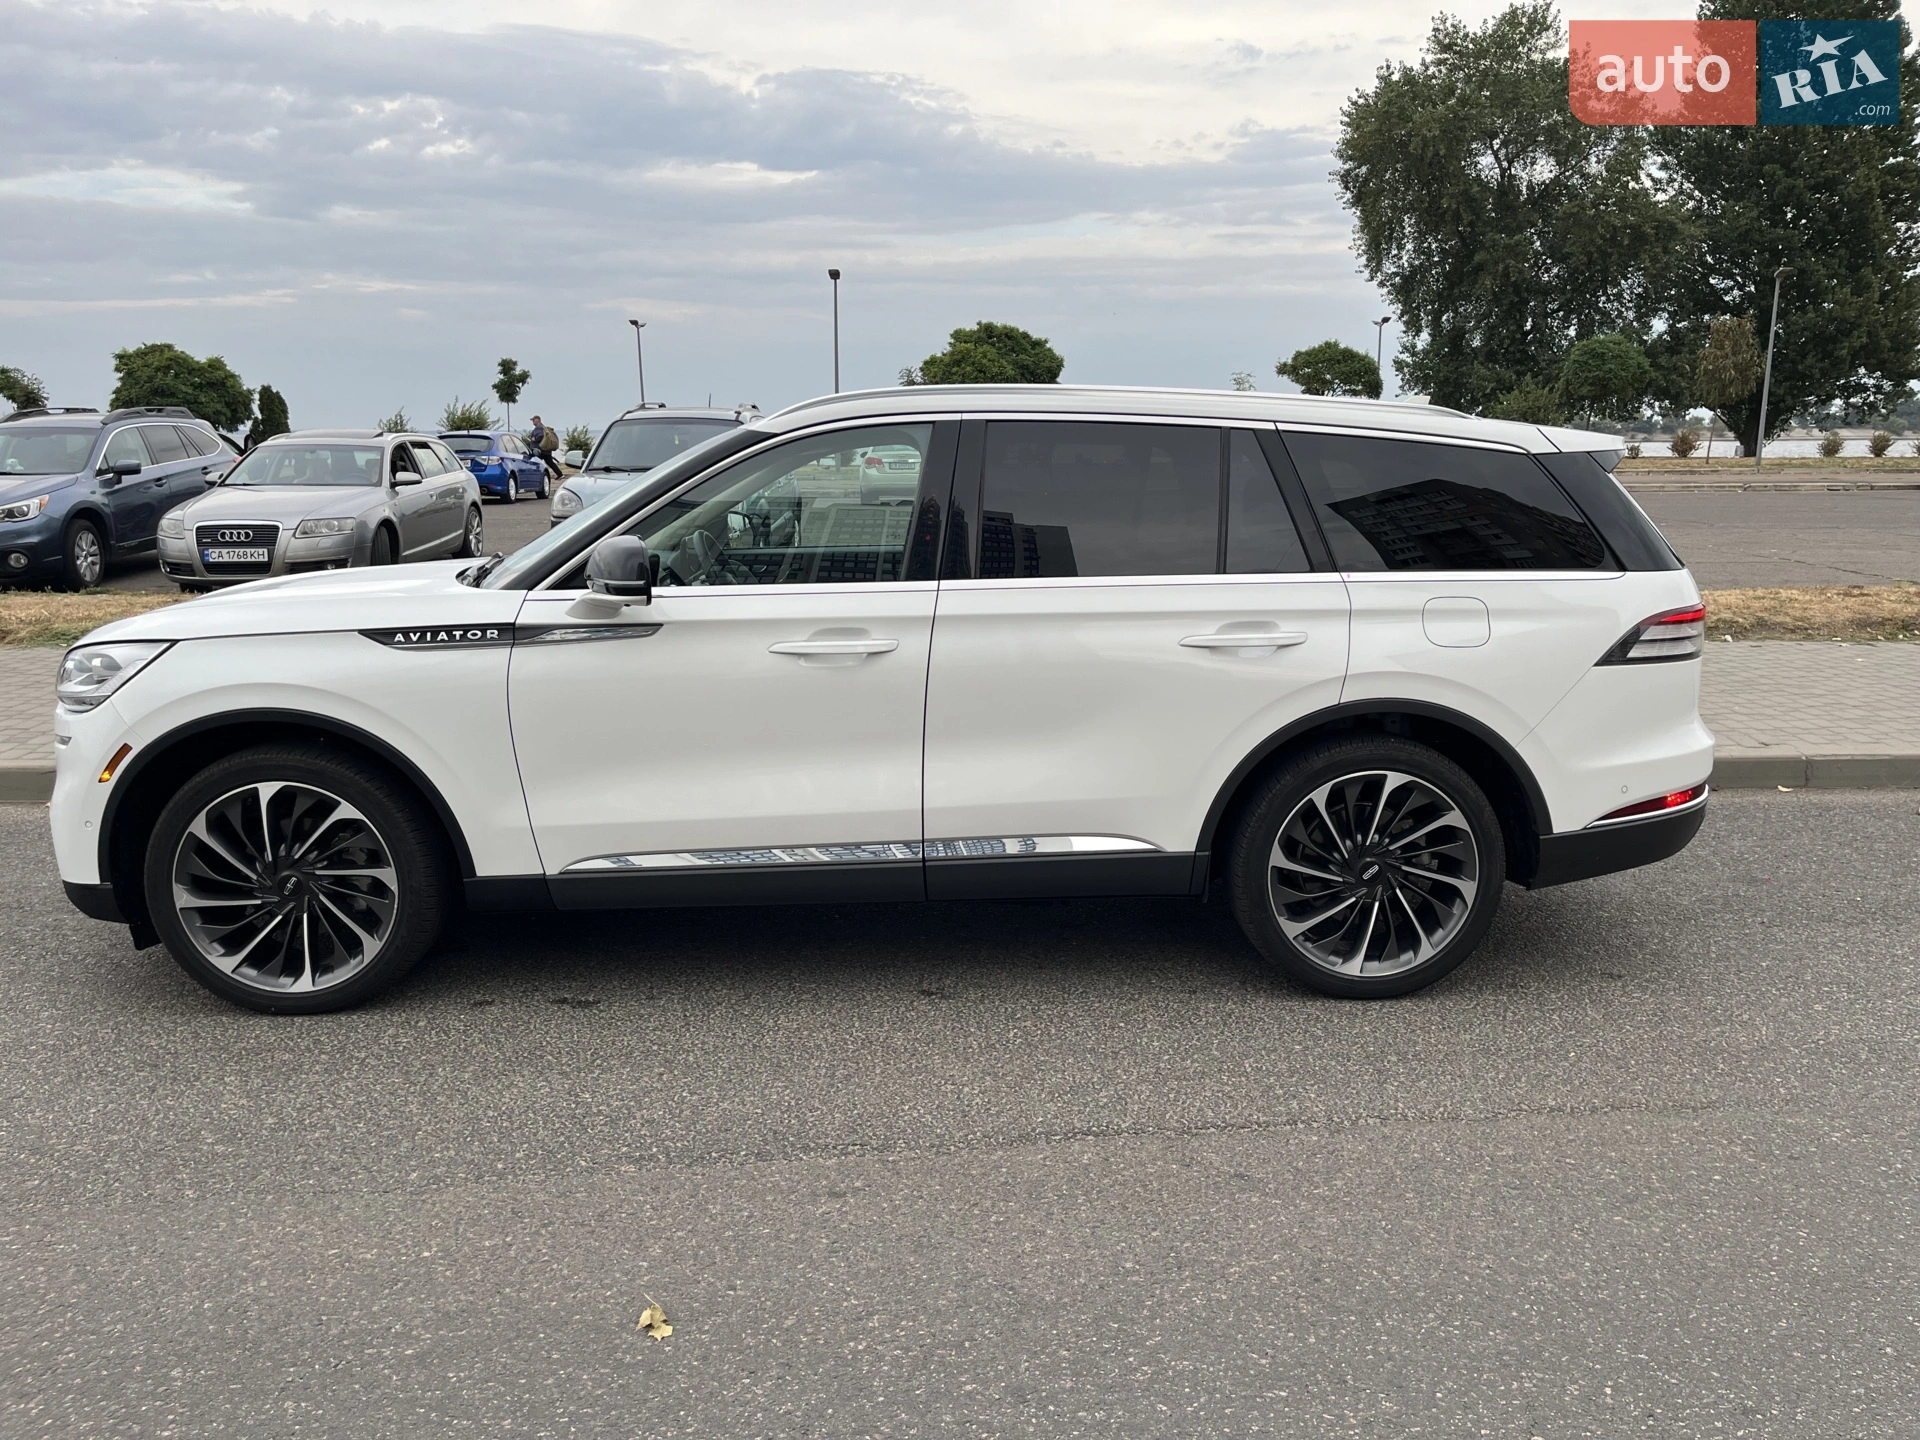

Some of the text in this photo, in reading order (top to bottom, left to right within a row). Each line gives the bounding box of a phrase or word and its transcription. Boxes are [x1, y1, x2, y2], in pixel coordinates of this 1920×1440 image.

[210, 550, 265, 560] CA 1768 KH
[394, 629, 499, 643] AVIATOR
